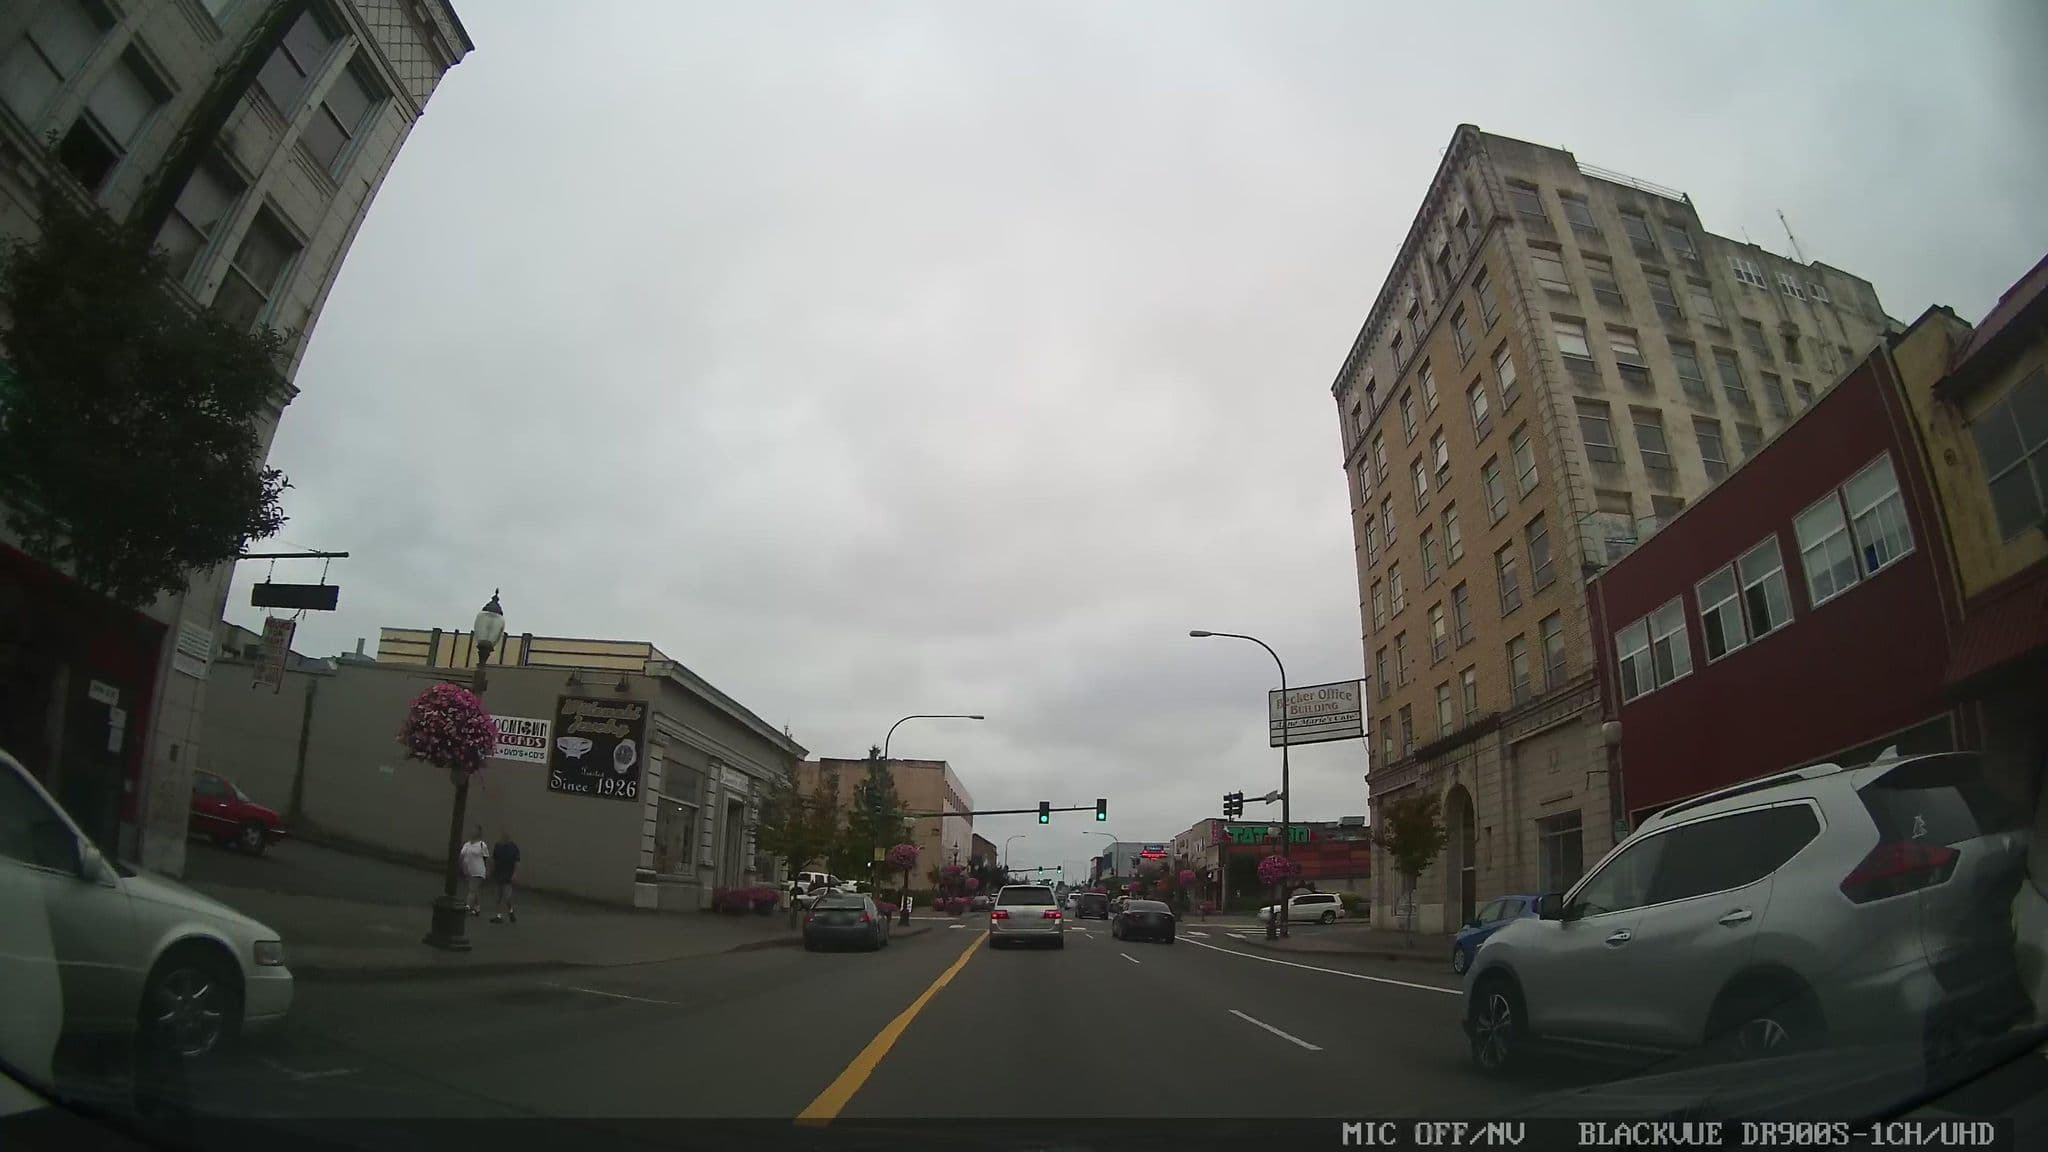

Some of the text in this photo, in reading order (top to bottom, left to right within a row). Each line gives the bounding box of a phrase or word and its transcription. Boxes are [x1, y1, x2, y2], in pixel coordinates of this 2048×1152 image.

[1318, 688, 1352, 701] Office
[496, 735, 543, 748] CORDS
[550, 769, 637, 797] Since 1926
[1230, 826, 1309, 844] TATOO
